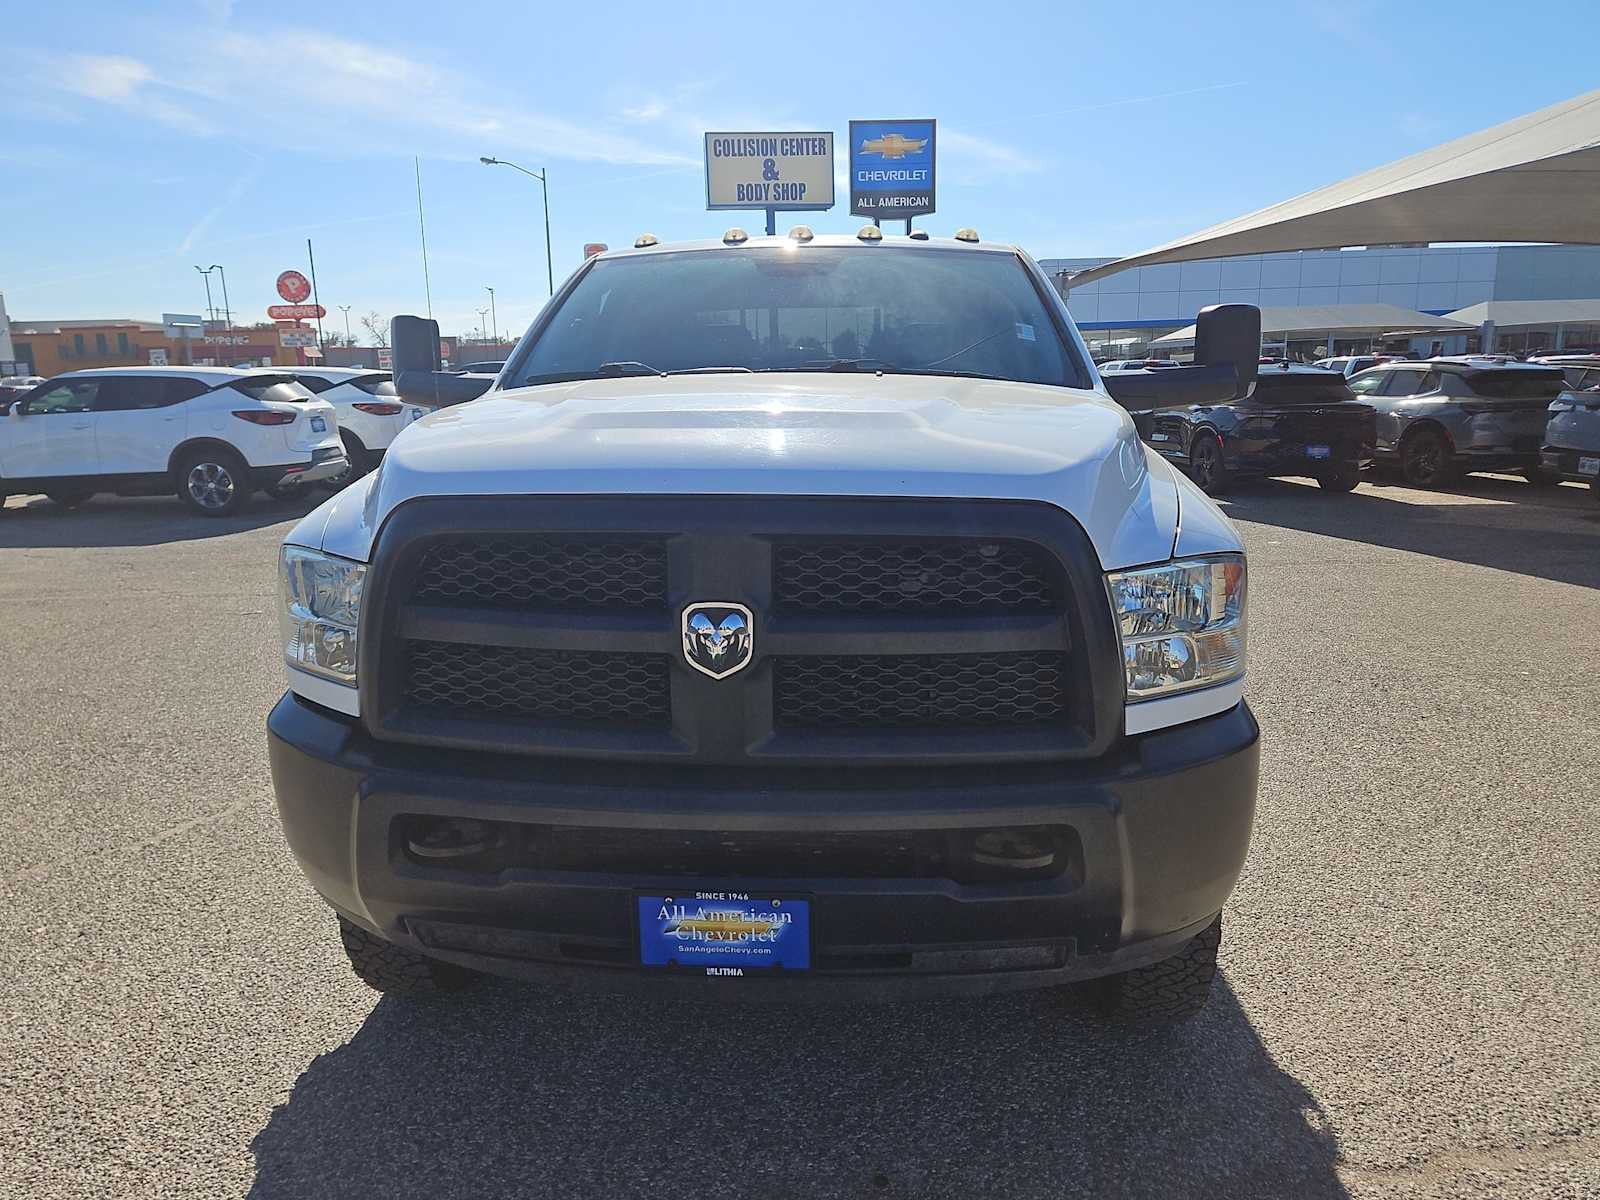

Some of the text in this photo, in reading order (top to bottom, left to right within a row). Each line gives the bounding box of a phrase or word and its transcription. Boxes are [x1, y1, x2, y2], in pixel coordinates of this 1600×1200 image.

[714, 137, 826, 157] COLLISION CENTER
[762, 158, 780, 181] &
[858, 169, 928, 182] CHEVROLET
[736, 182, 806, 202] BODY SHOP
[857, 196, 929, 208] ALL AMERICAN
[695, 892, 749, 901] SINCE 1946
[657, 905, 793, 924] All American
[675, 925, 777, 943] Chevrolet
[678, 945, 772, 955] SanAngeloChevy.com
[714, 967, 744, 977] LITHIA
